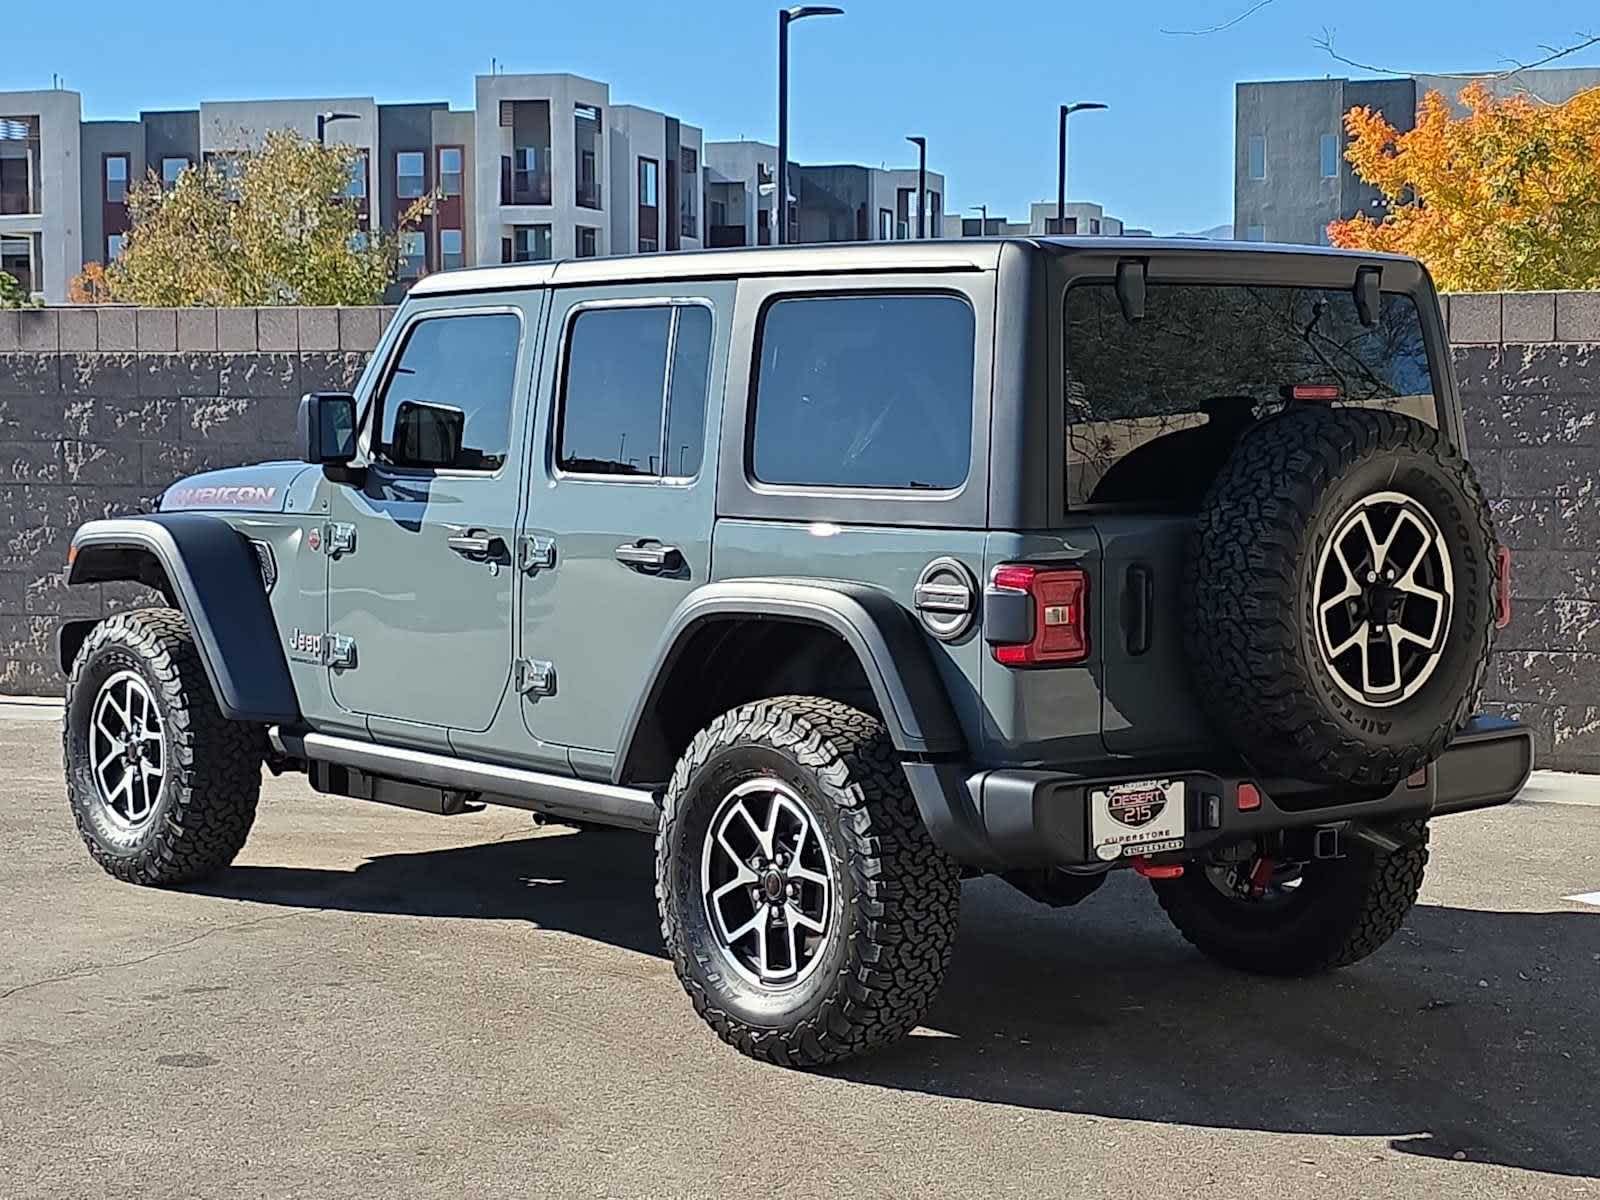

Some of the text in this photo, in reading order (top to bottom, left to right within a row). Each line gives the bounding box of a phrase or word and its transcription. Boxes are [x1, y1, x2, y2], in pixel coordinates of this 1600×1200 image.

[289, 627, 321, 659] Jeep
[1111, 790, 1162, 807] DESERT
[1124, 806, 1151, 823] 215
[1104, 829, 1171, 845] SUPERSTORE
